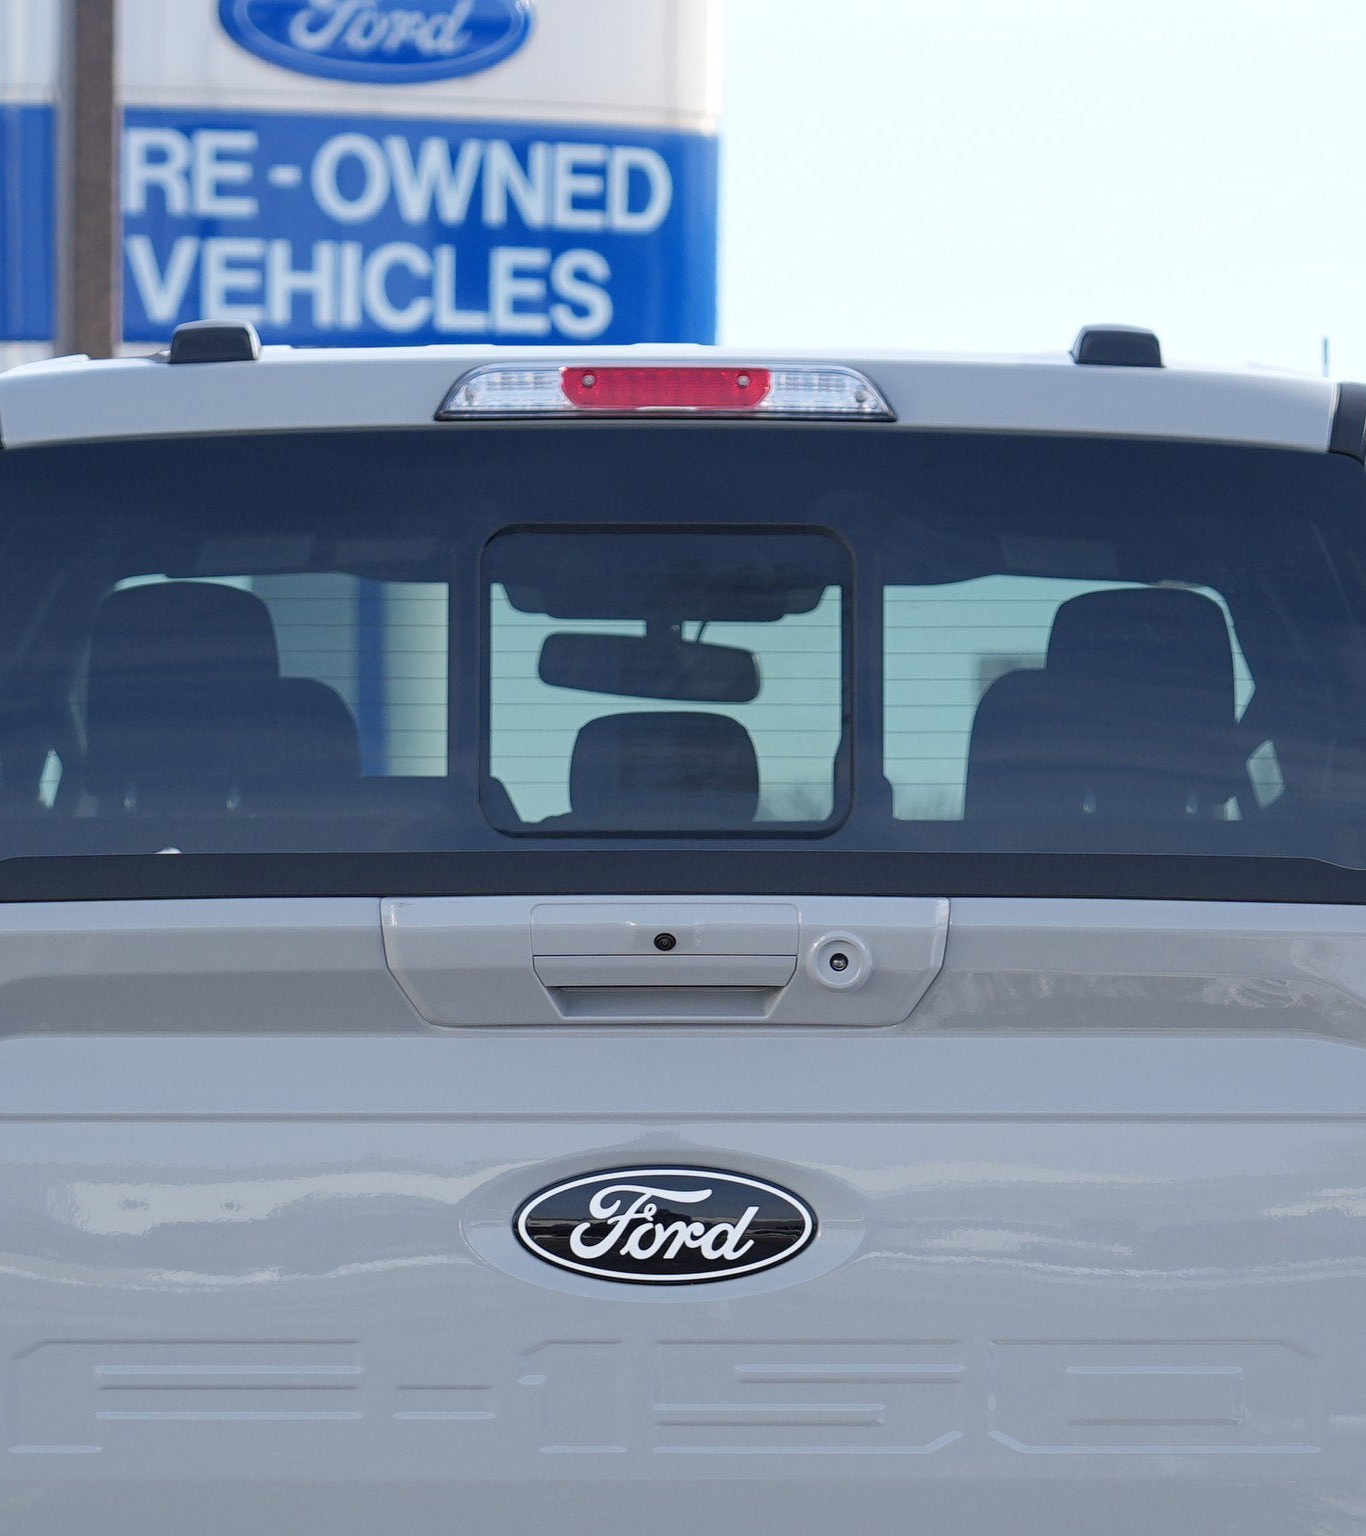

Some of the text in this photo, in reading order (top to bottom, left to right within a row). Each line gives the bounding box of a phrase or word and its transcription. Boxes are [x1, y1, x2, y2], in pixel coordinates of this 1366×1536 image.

[126, 235, 613, 340] VEHICLES
[570, 1184, 759, 1260] Ford
[8, 1337, 1320, 1454] F-150
